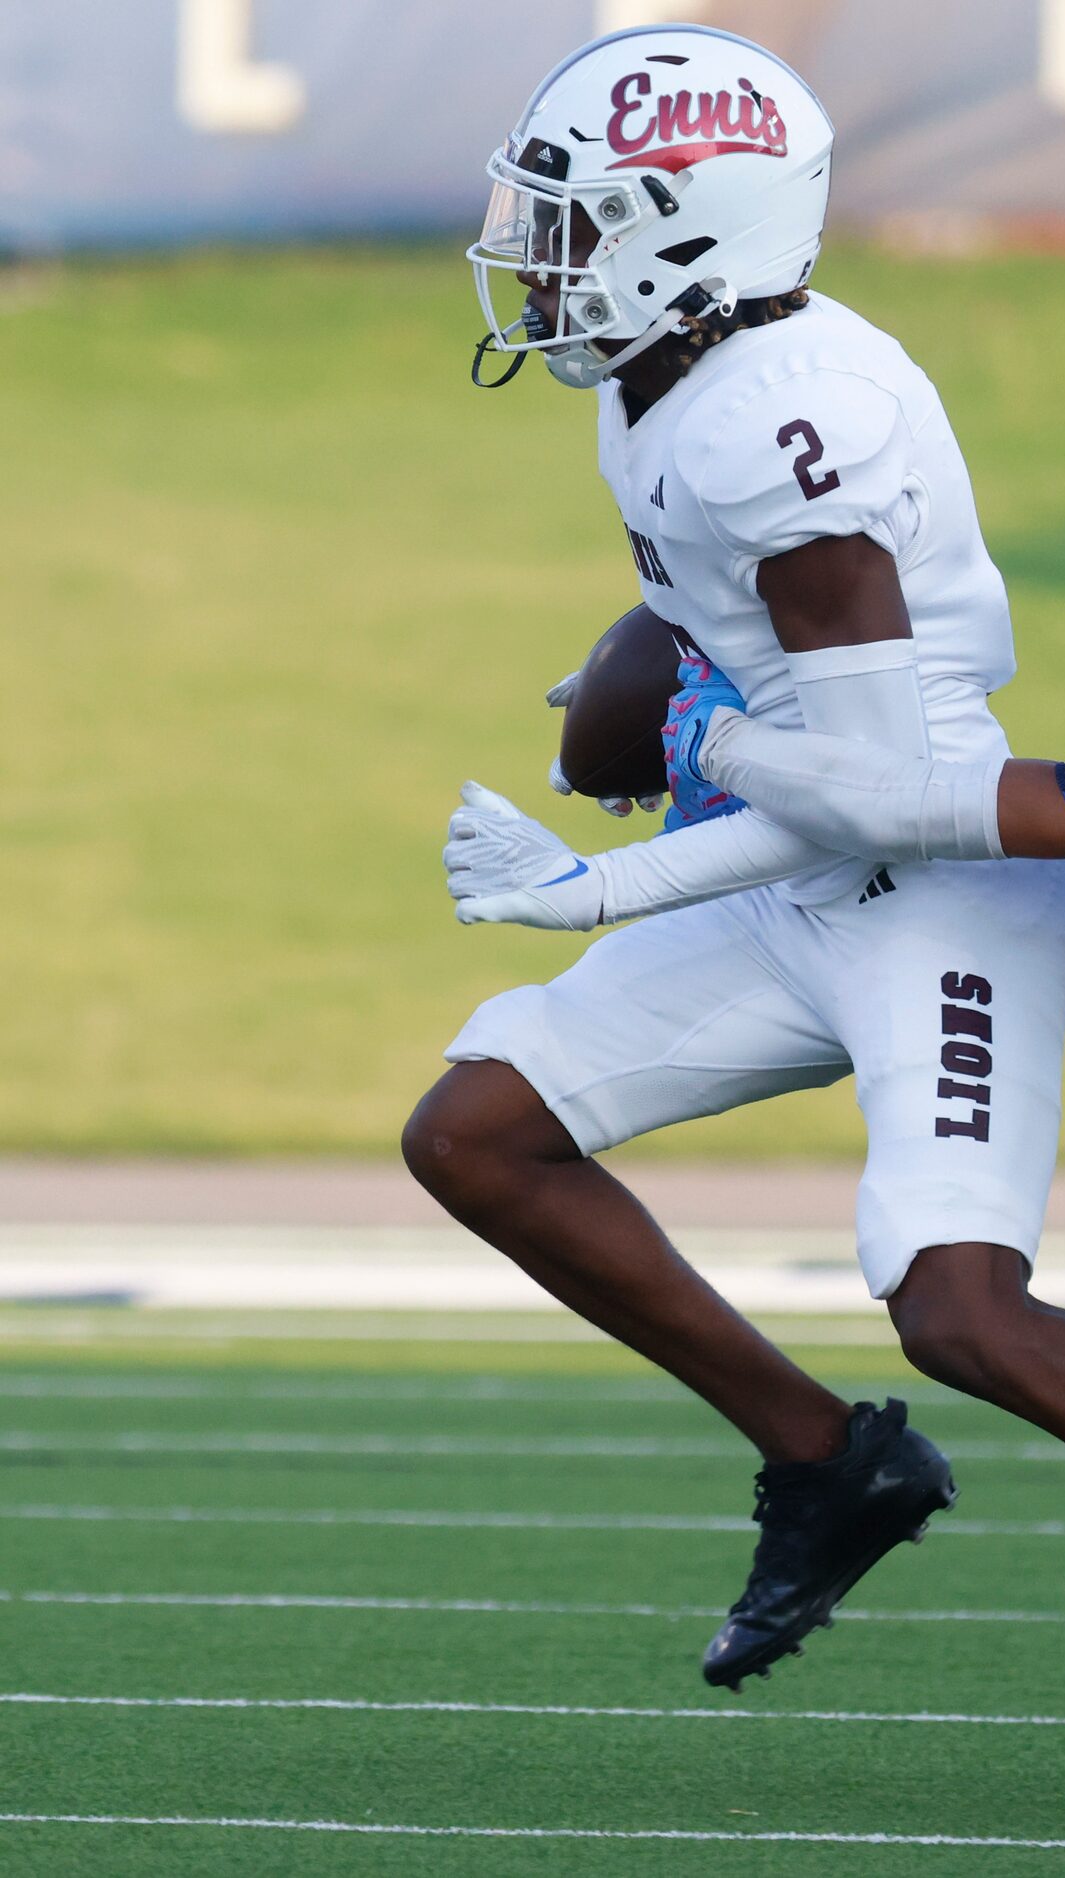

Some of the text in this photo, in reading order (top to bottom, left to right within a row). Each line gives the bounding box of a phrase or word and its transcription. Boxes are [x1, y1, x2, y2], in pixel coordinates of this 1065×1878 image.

[606, 71, 788, 160] Ennis
[777, 418, 841, 500] 2
[935, 971, 993, 1143] LIONS
